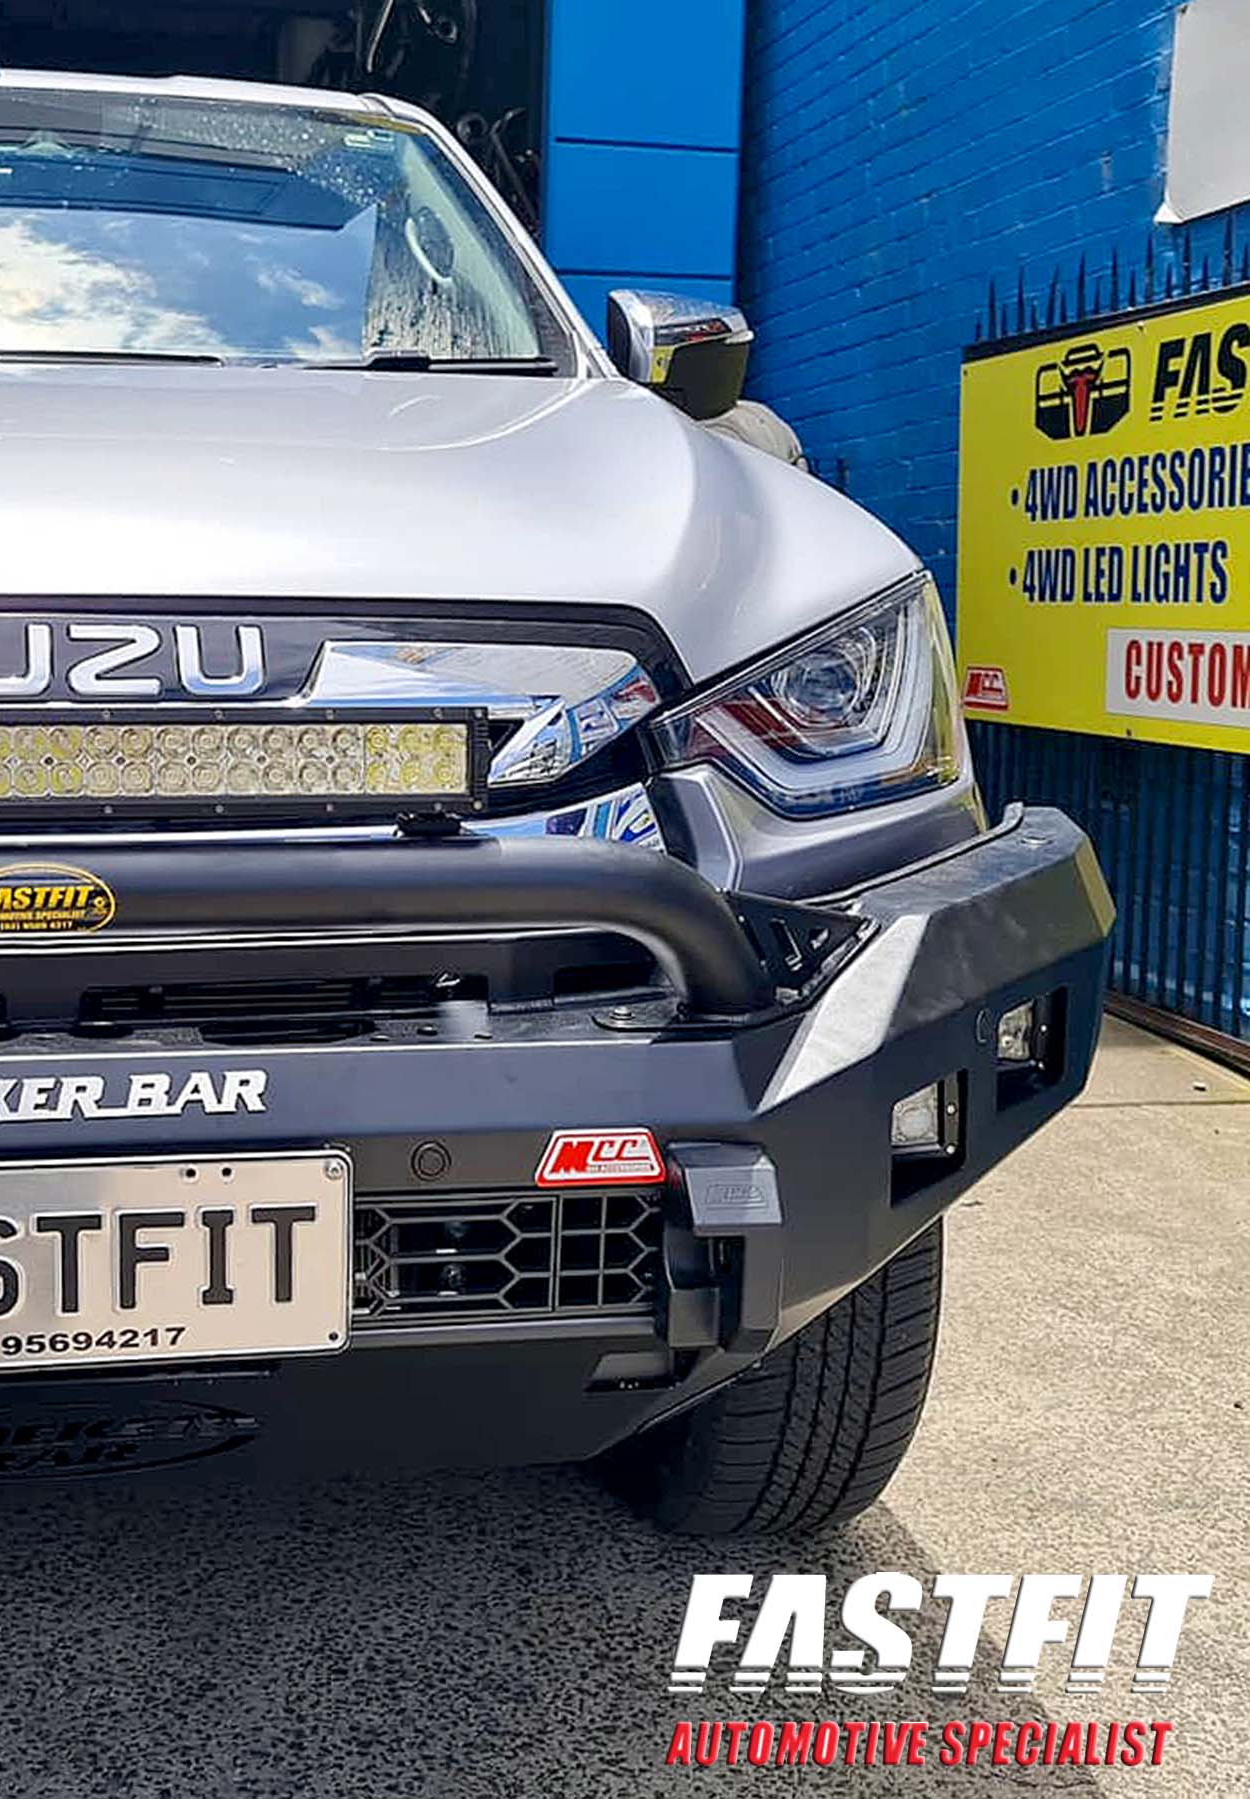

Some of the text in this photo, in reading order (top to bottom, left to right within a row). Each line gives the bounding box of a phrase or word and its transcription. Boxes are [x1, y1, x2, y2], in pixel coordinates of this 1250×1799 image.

[1150, 323, 1250, 421] FAS
[1025, 442, 1250, 522] 4WD ACCESSORIE
[1023, 540, 1228, 604] 4WD LED LIGHTS
[1124, 639, 1250, 709] CUSTOM
[127, 1070, 267, 1116] BAR
[550, 1139, 650, 1174] MCC
[1, 1326, 187, 1357] 95694217
